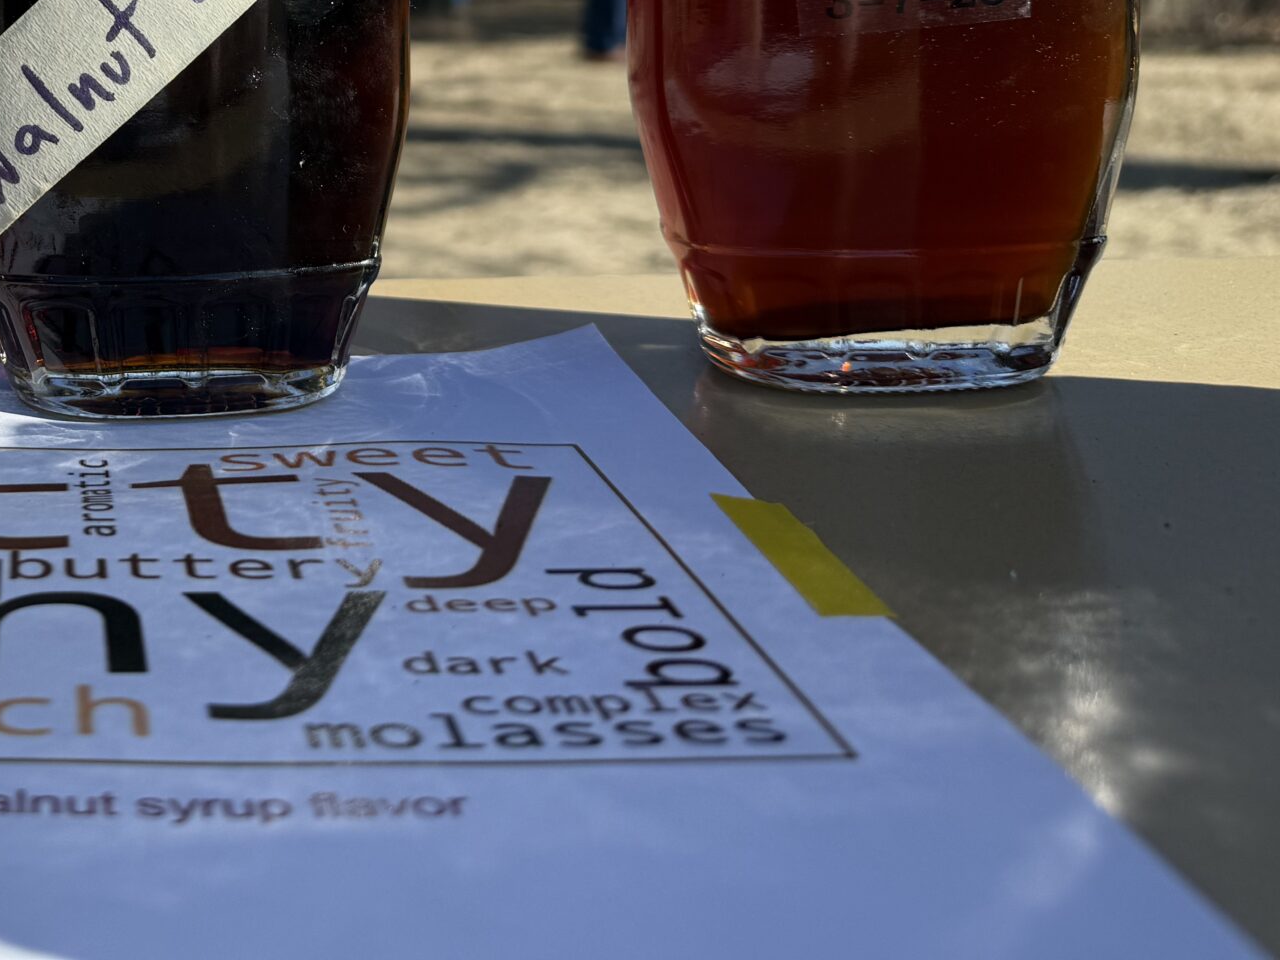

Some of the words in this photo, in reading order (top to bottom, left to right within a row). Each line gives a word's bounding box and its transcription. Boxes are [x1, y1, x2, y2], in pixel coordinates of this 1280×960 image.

[221, 443, 534, 472] sweet
[69, 457, 116, 537] aromatic
[312, 477, 374, 549] fruity
[8, 552, 381, 586] buttery
[405, 591, 557, 616] deep
[544, 567, 735, 688] bold
[403, 650, 570, 675] dark
[463, 685, 766, 721] complex
[304, 714, 786, 751] molasses
[137, 793, 291, 823] syrup
[310, 791, 466, 819] flavor
